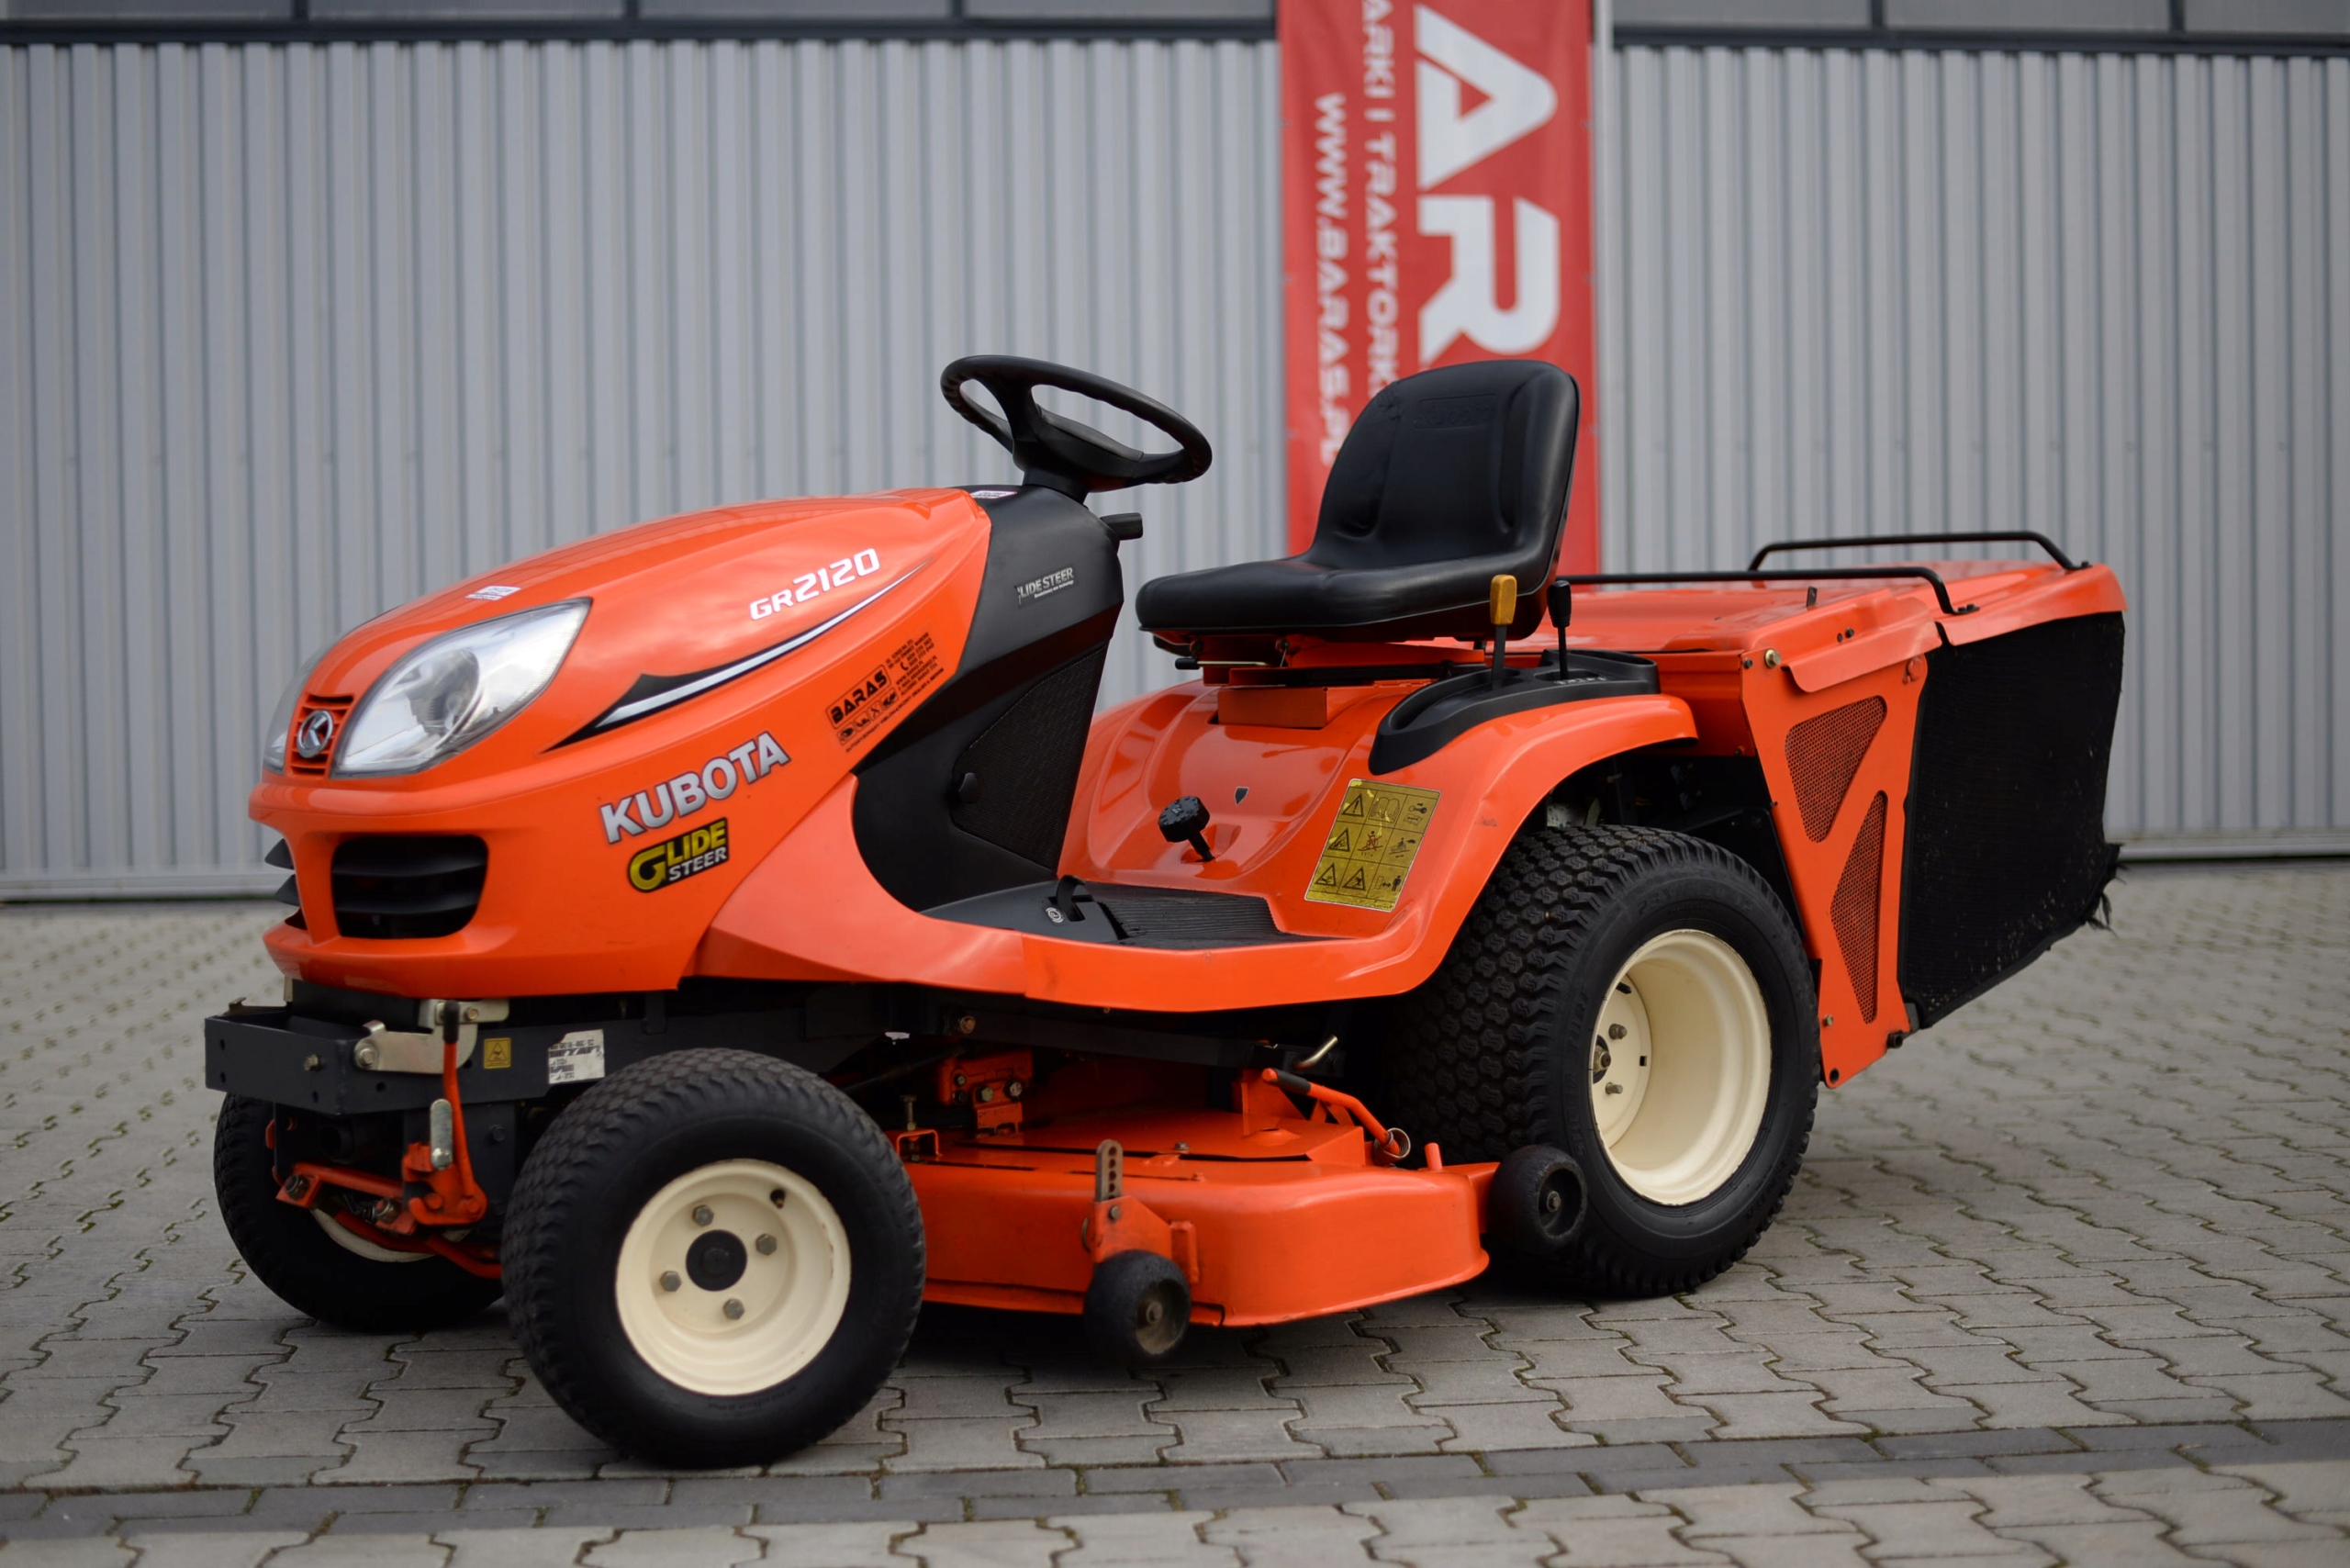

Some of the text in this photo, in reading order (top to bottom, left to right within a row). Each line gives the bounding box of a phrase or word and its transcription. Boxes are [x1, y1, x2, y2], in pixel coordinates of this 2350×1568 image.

[1363, 106, 1396, 122] I
[749, 548, 880, 621] GR2120
[1016, 578, 1043, 599] LIDE
[830, 671, 887, 723] BARAS
[599, 731, 791, 844] KUBOTA
[629, 820, 726, 890] GLIDE
[669, 846, 727, 881] STEER
